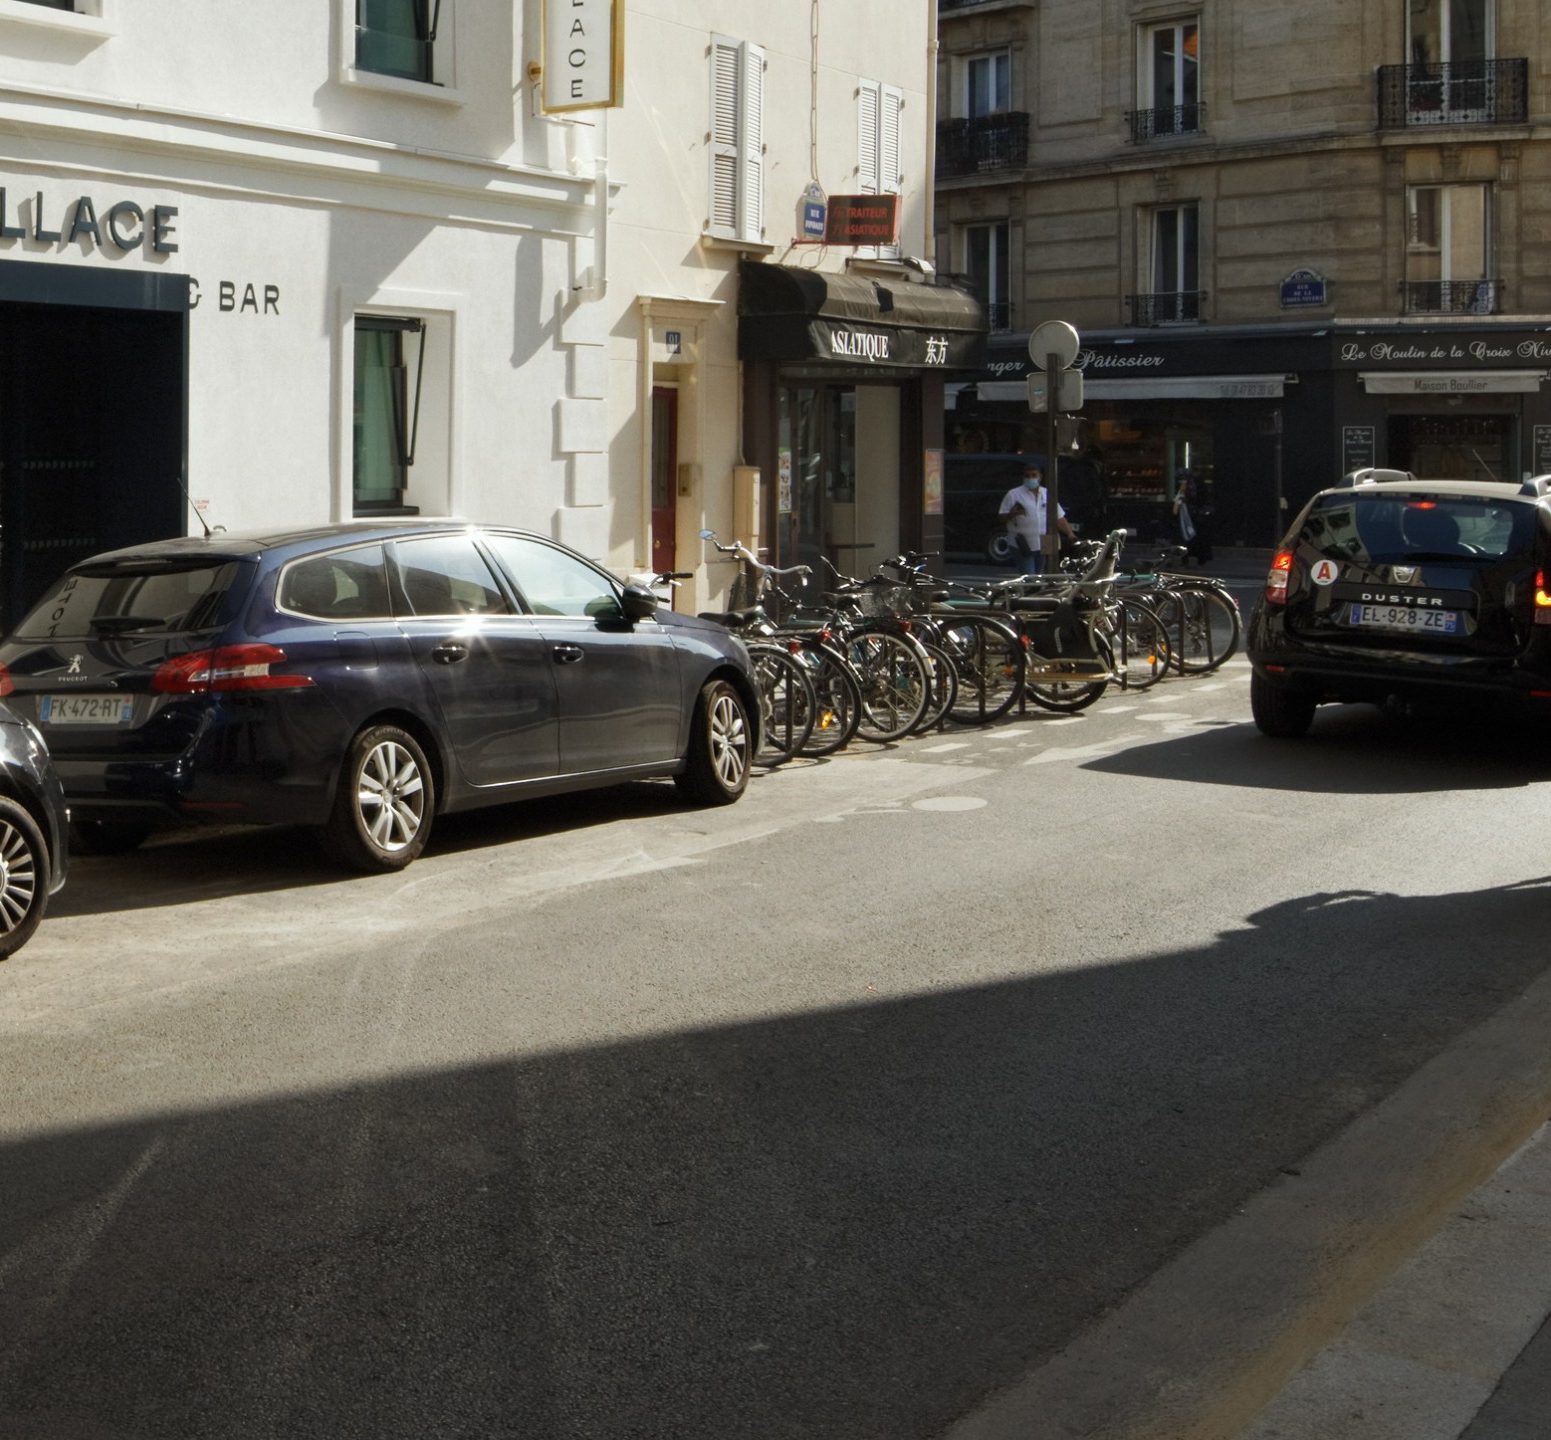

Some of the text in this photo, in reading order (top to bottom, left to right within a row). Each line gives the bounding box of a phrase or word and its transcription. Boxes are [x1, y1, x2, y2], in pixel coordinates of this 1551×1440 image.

[846, 207, 888, 219] TRAITEUR
[844, 223, 890, 235] ASIATIQUE
[219, 280, 280, 315] BAR
[831, 330, 889, 362] ASIATIQUE
[925, 336, 949, 365] 东方
[1341, 343, 1366, 361] Le
[1370, 342, 1428, 360] Moulin
[1430, 346, 1447, 358] de
[1450, 344, 1465, 358] la
[1469, 340, 1512, 361] Croix
[1072, 348, 1165, 370] Pâtissier
[1414, 380, 1448, 391] Maison
[1316, 561, 1331, 580] A
[1361, 593, 1443, 606] DUSTER
[1362, 606, 1444, 628] EL-928-ZE
[50, 698, 122, 718] FK-472-RT
